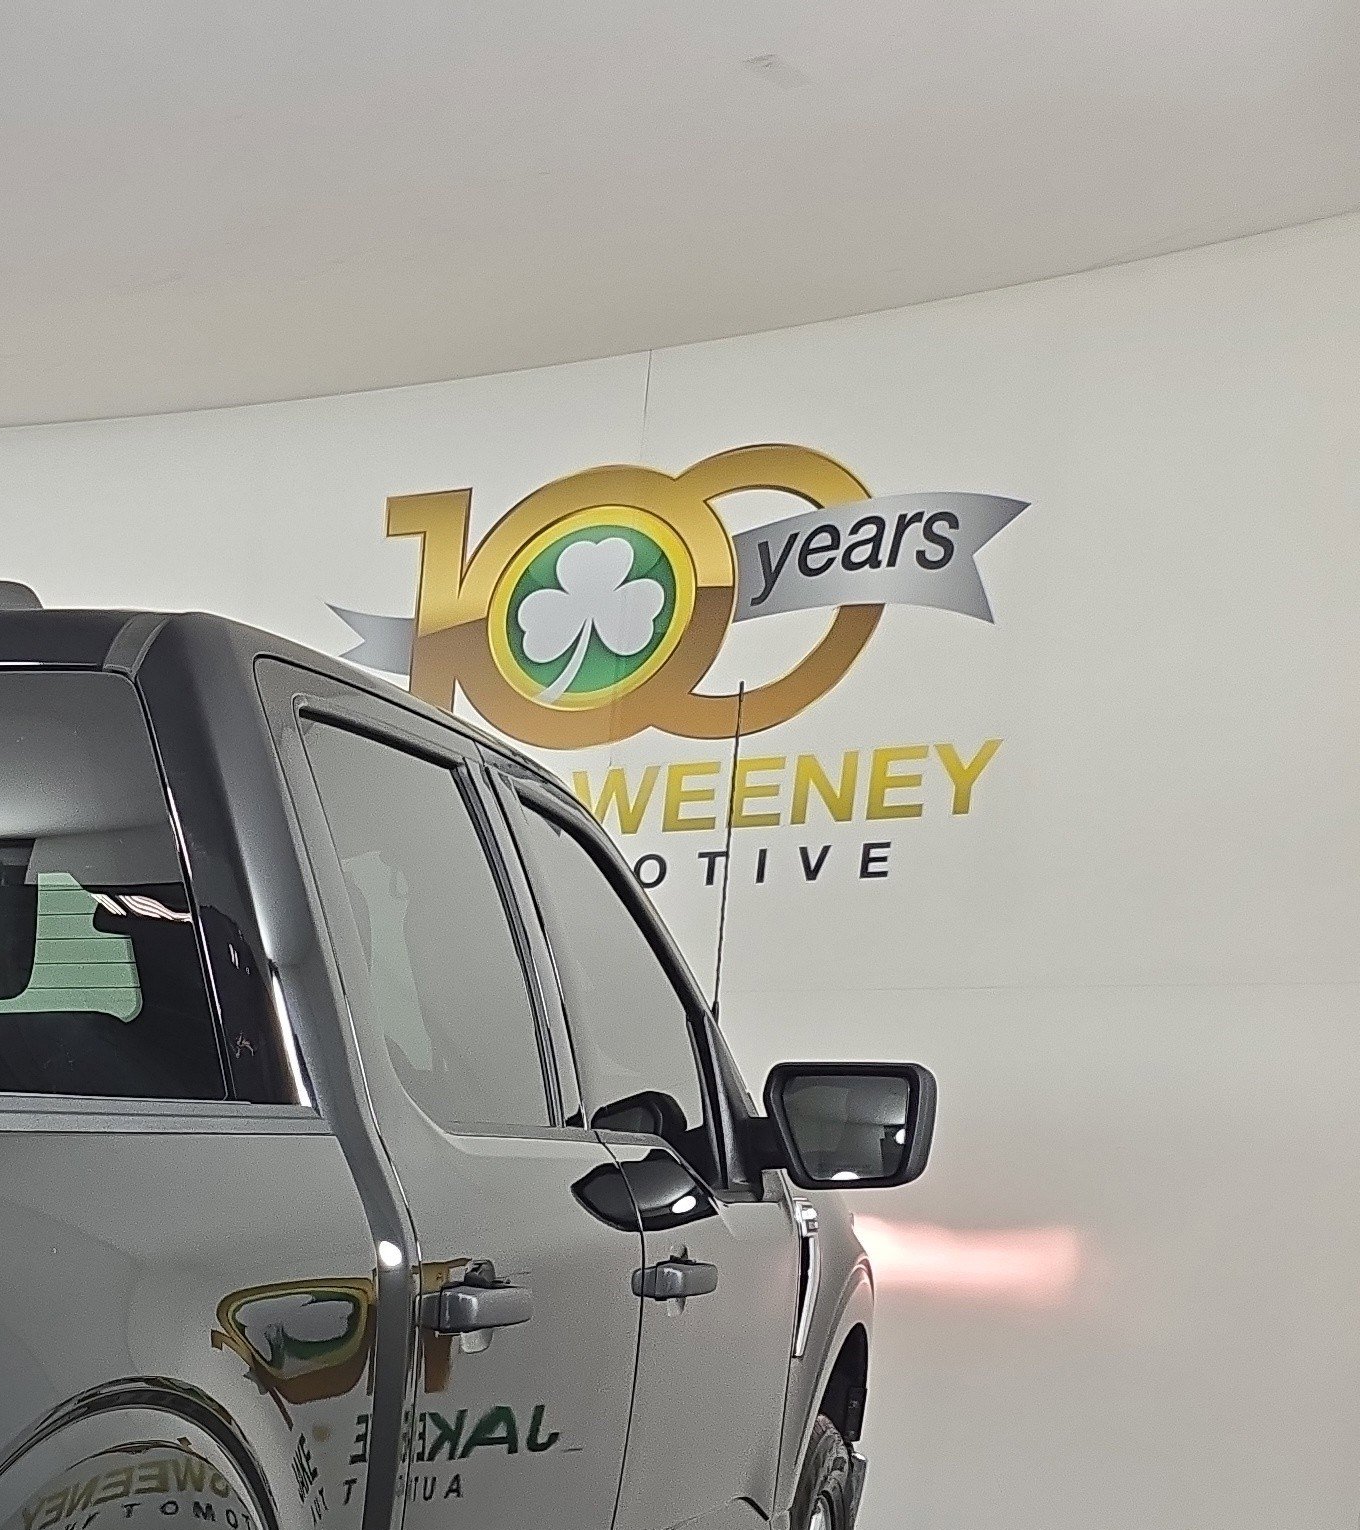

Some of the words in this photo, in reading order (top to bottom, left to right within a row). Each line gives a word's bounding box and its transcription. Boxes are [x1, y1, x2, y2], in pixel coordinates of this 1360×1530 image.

[749, 507, 961, 607] years
[572, 738, 1005, 836] WEENEY
[632, 841, 893, 890] OTIVE
